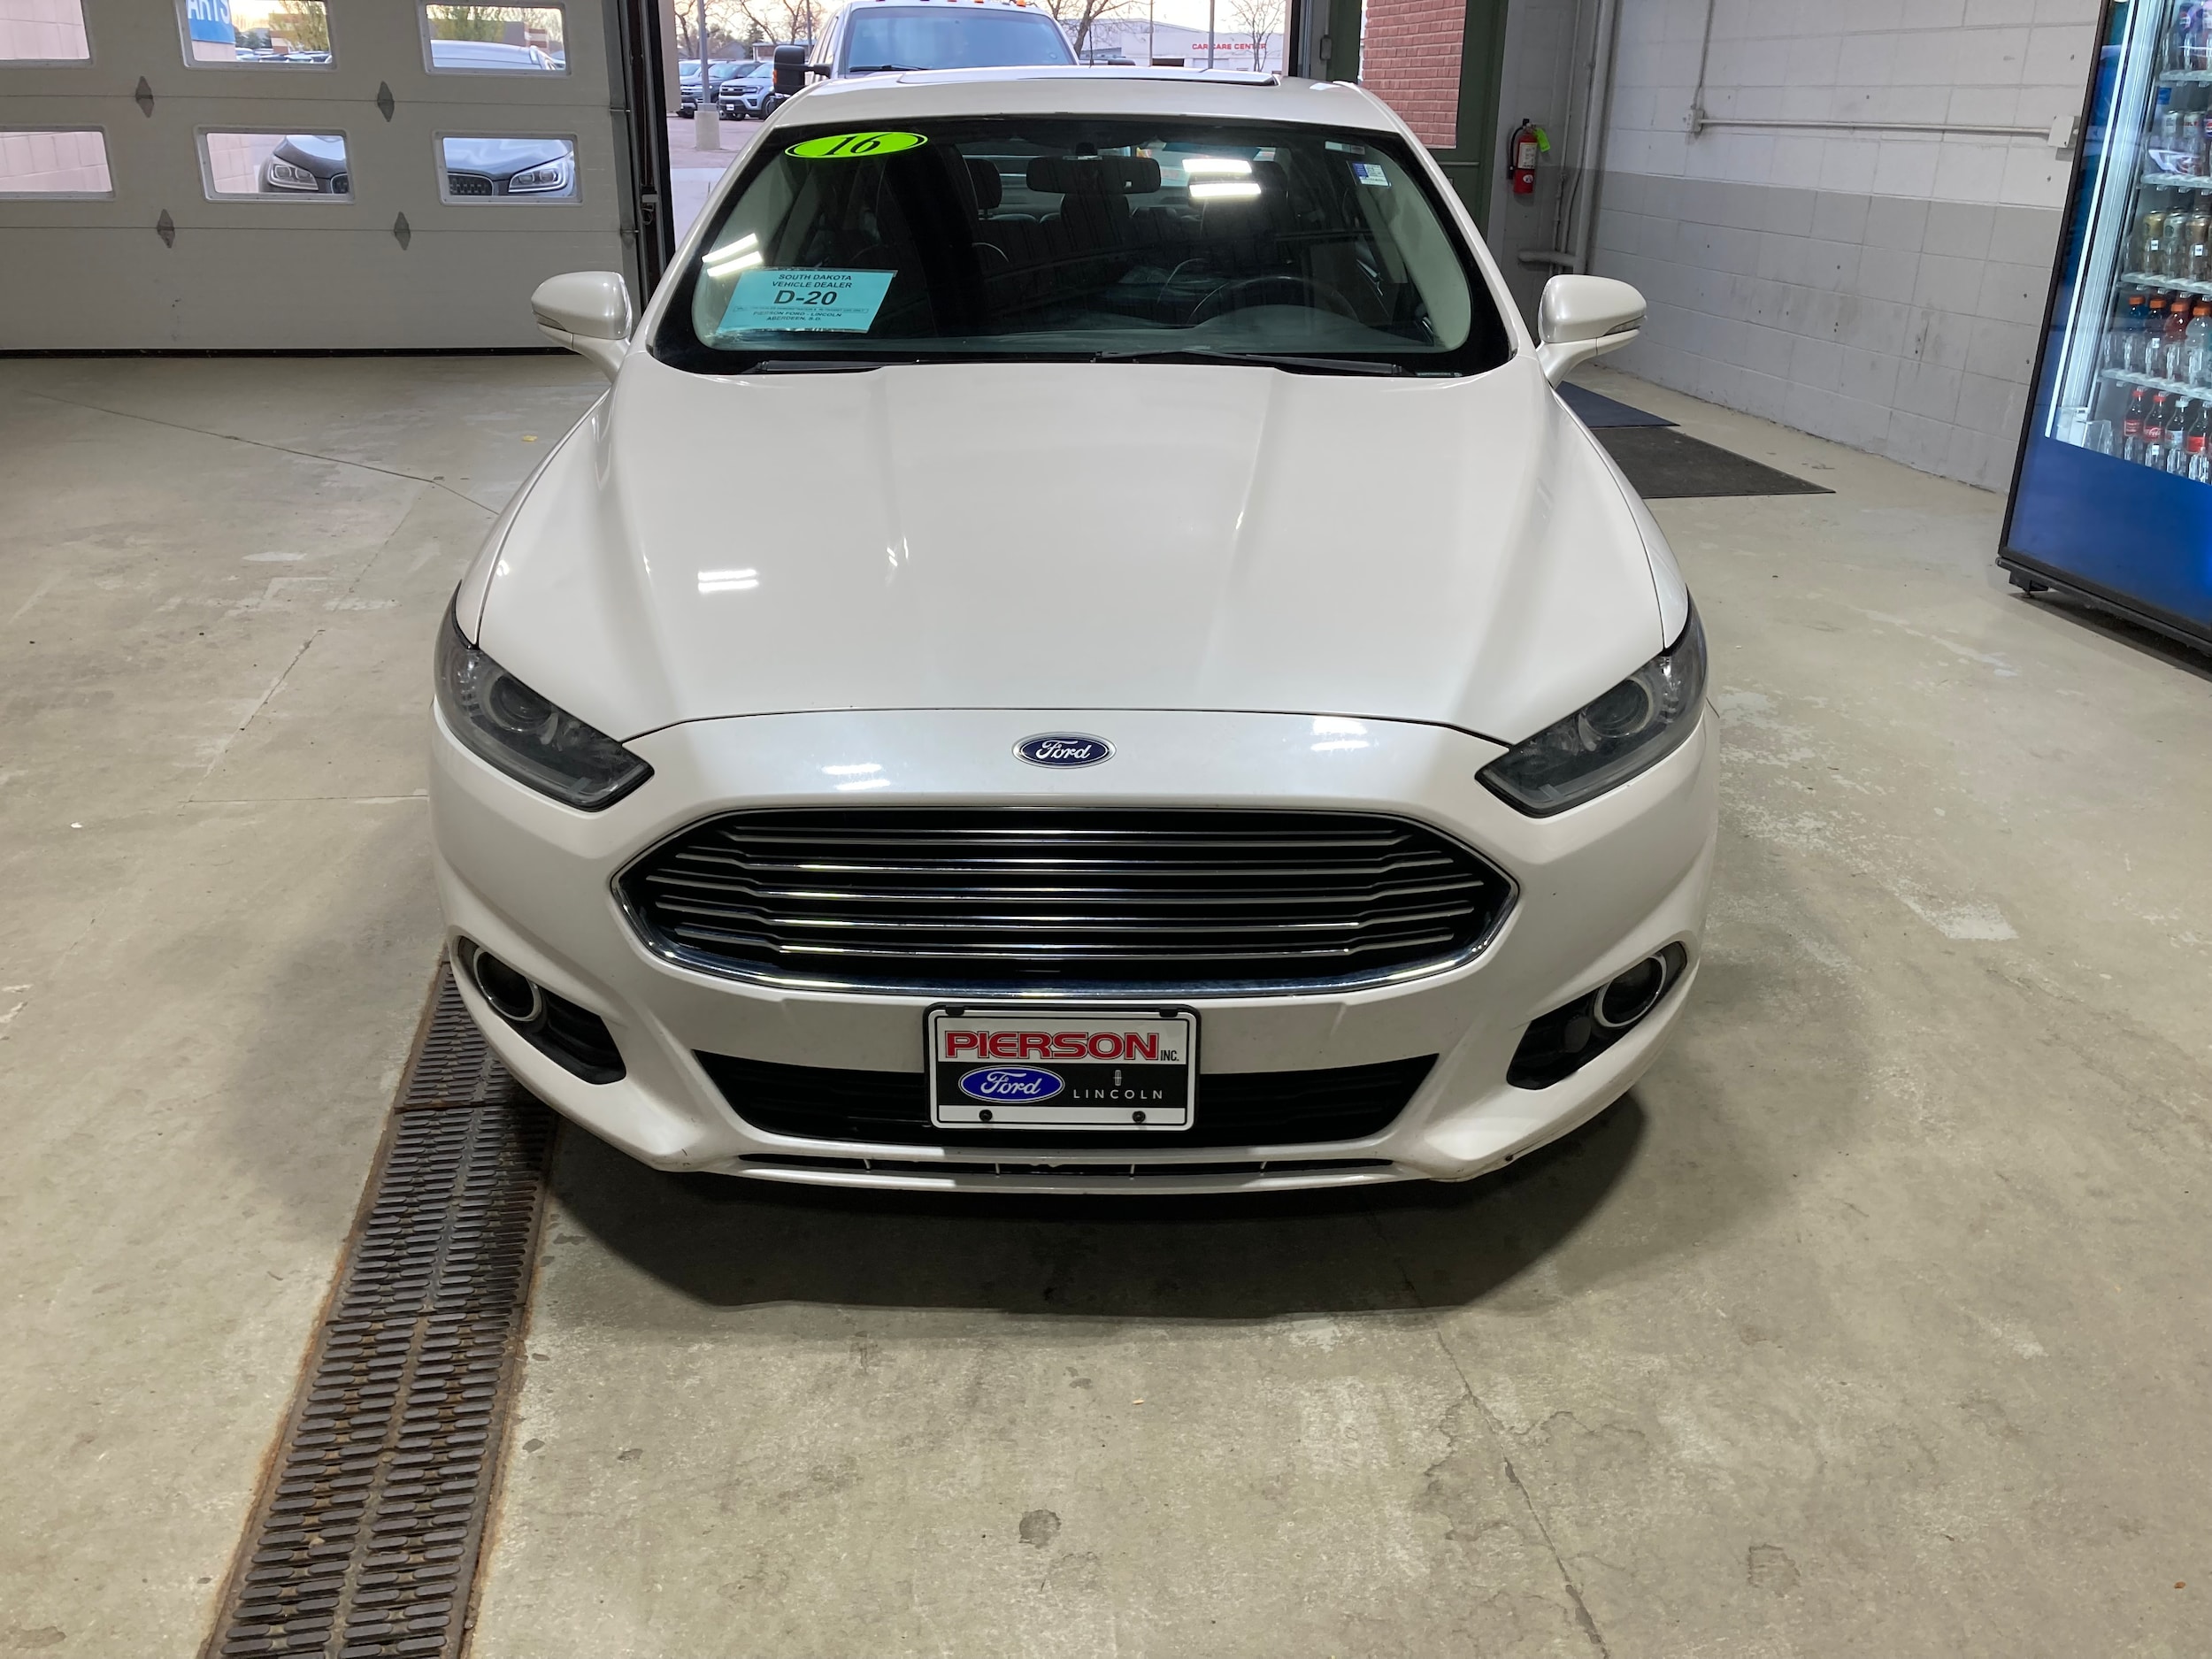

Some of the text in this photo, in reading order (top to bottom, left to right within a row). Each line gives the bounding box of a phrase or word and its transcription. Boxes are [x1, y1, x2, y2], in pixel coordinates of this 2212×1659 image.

[821, 133, 892, 157] 16
[773, 289, 838, 305] D-20
[1035, 740, 1092, 759] Ford
[945, 1030, 1179, 1061] PIERSON INC.
[979, 1071, 1042, 1095] Ford
[1073, 1089, 1164, 1100] LINCOLN
